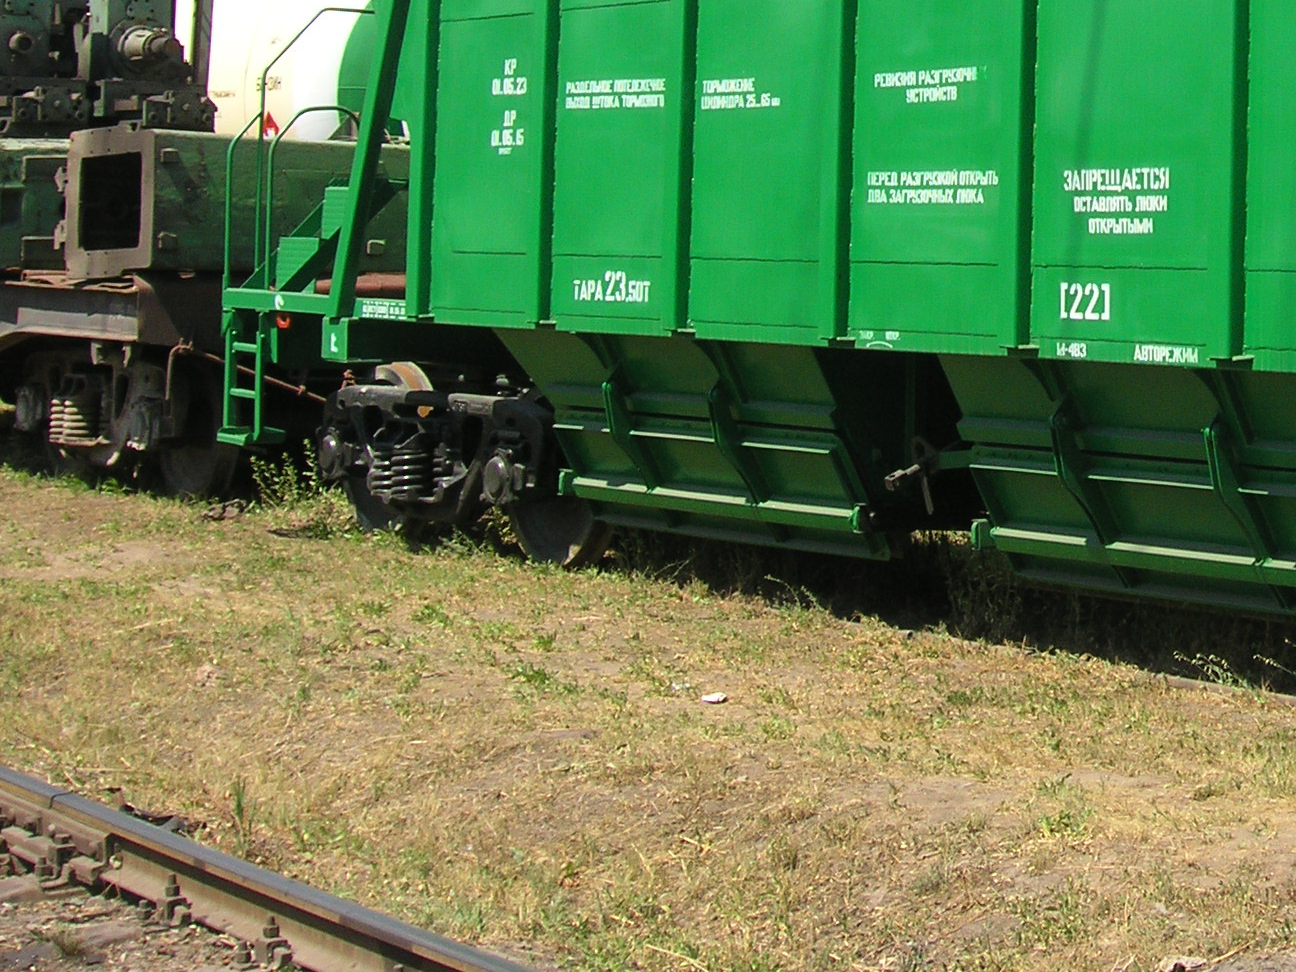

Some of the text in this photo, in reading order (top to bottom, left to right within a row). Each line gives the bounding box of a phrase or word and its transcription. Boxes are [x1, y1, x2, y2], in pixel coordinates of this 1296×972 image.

[504, 58, 517, 75] КР
[491, 77, 528, 96] 01.05.23
[874, 71, 917, 88] РЕВИЗИЯ
[905, 84, 958, 104] УСТРОЙСТВ
[503, 110, 517, 127] ДР
[867, 168, 999, 187] ПЕРЕД РАЗГРУЗКОЙ ОТКРЫТЬ
[1063, 167, 1170, 192] ЗАПРЕЩАЕТСЯ
[867, 188, 985, 204] ДВА ЗАГРУЗОЧНЫХ ЛЮКА
[1073, 195, 1168, 213] ОСТАВЛЯТЬ ЛЮКИ
[1088, 218, 1154, 234] ОТКРЫТЫМИ
[573, 279, 603, 301] ТАРА
[1060, 282, 1110, 320] [22]
[1134, 343, 1199, 364] АВТОРЕЖИМ
